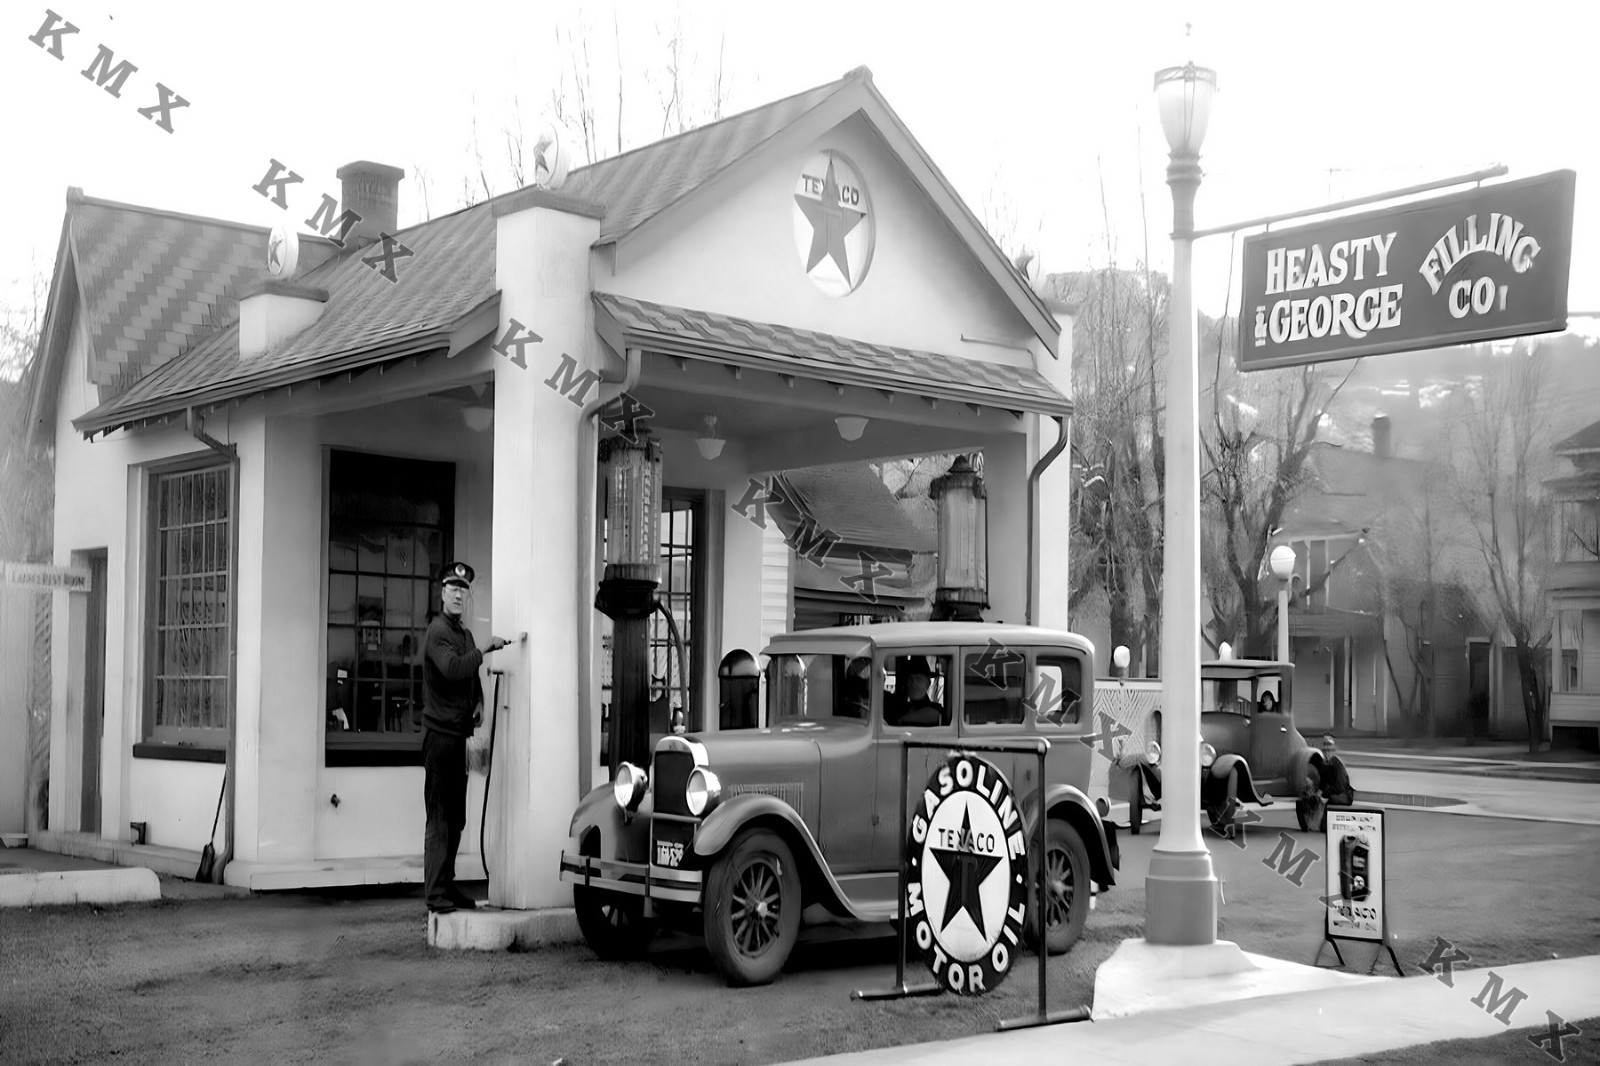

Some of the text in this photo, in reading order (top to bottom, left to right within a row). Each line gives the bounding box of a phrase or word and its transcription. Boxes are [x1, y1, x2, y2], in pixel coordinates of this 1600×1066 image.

[1264, 231, 1397, 295] HEASTY
[1419, 212, 1542, 296] FILLING
[1268, 283, 1404, 344] GEORGE
[912, 759, 1026, 861] GASOLINE
[907, 882, 986, 993] MOTOR
[991, 902, 1026, 973] OIL
